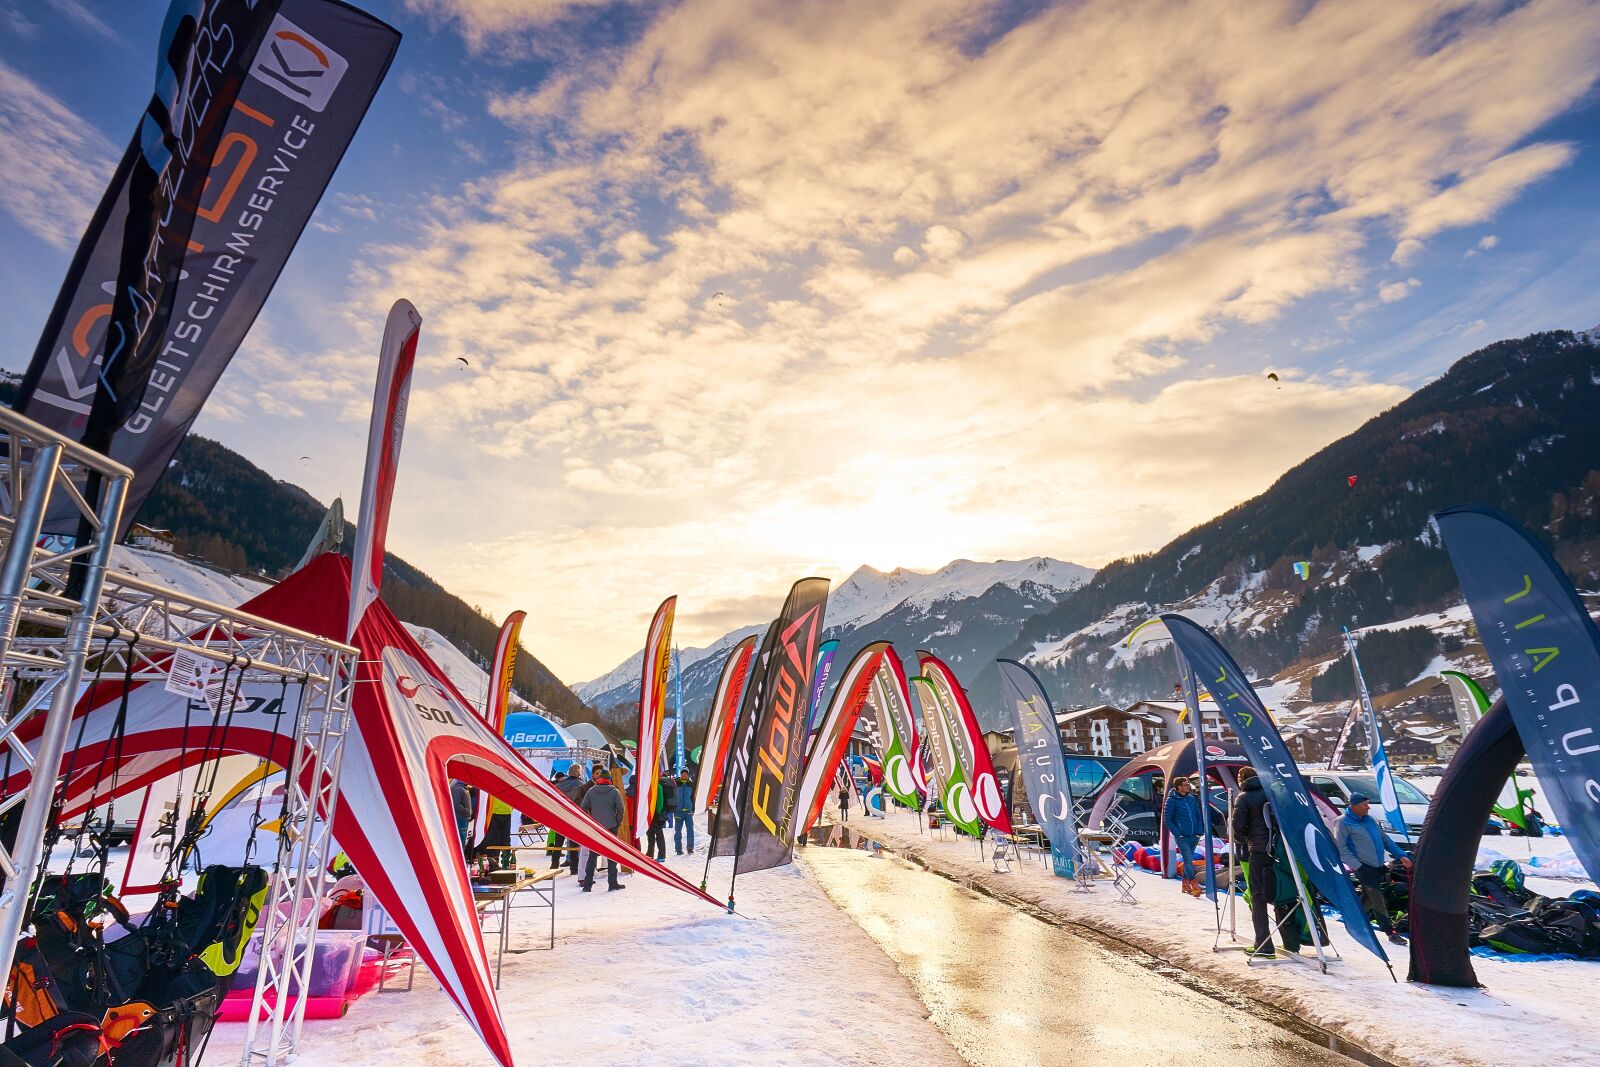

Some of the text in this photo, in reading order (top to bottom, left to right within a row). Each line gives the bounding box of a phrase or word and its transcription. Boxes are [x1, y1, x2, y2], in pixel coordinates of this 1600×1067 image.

[124, 114, 316, 434] GLEITSCHIRMSERVICE
[415, 703, 464, 727] SOL
[504, 732, 558, 744] yBean
[752, 668, 797, 836] Flow
[779, 697, 808, 848] PARAGLIDERS
